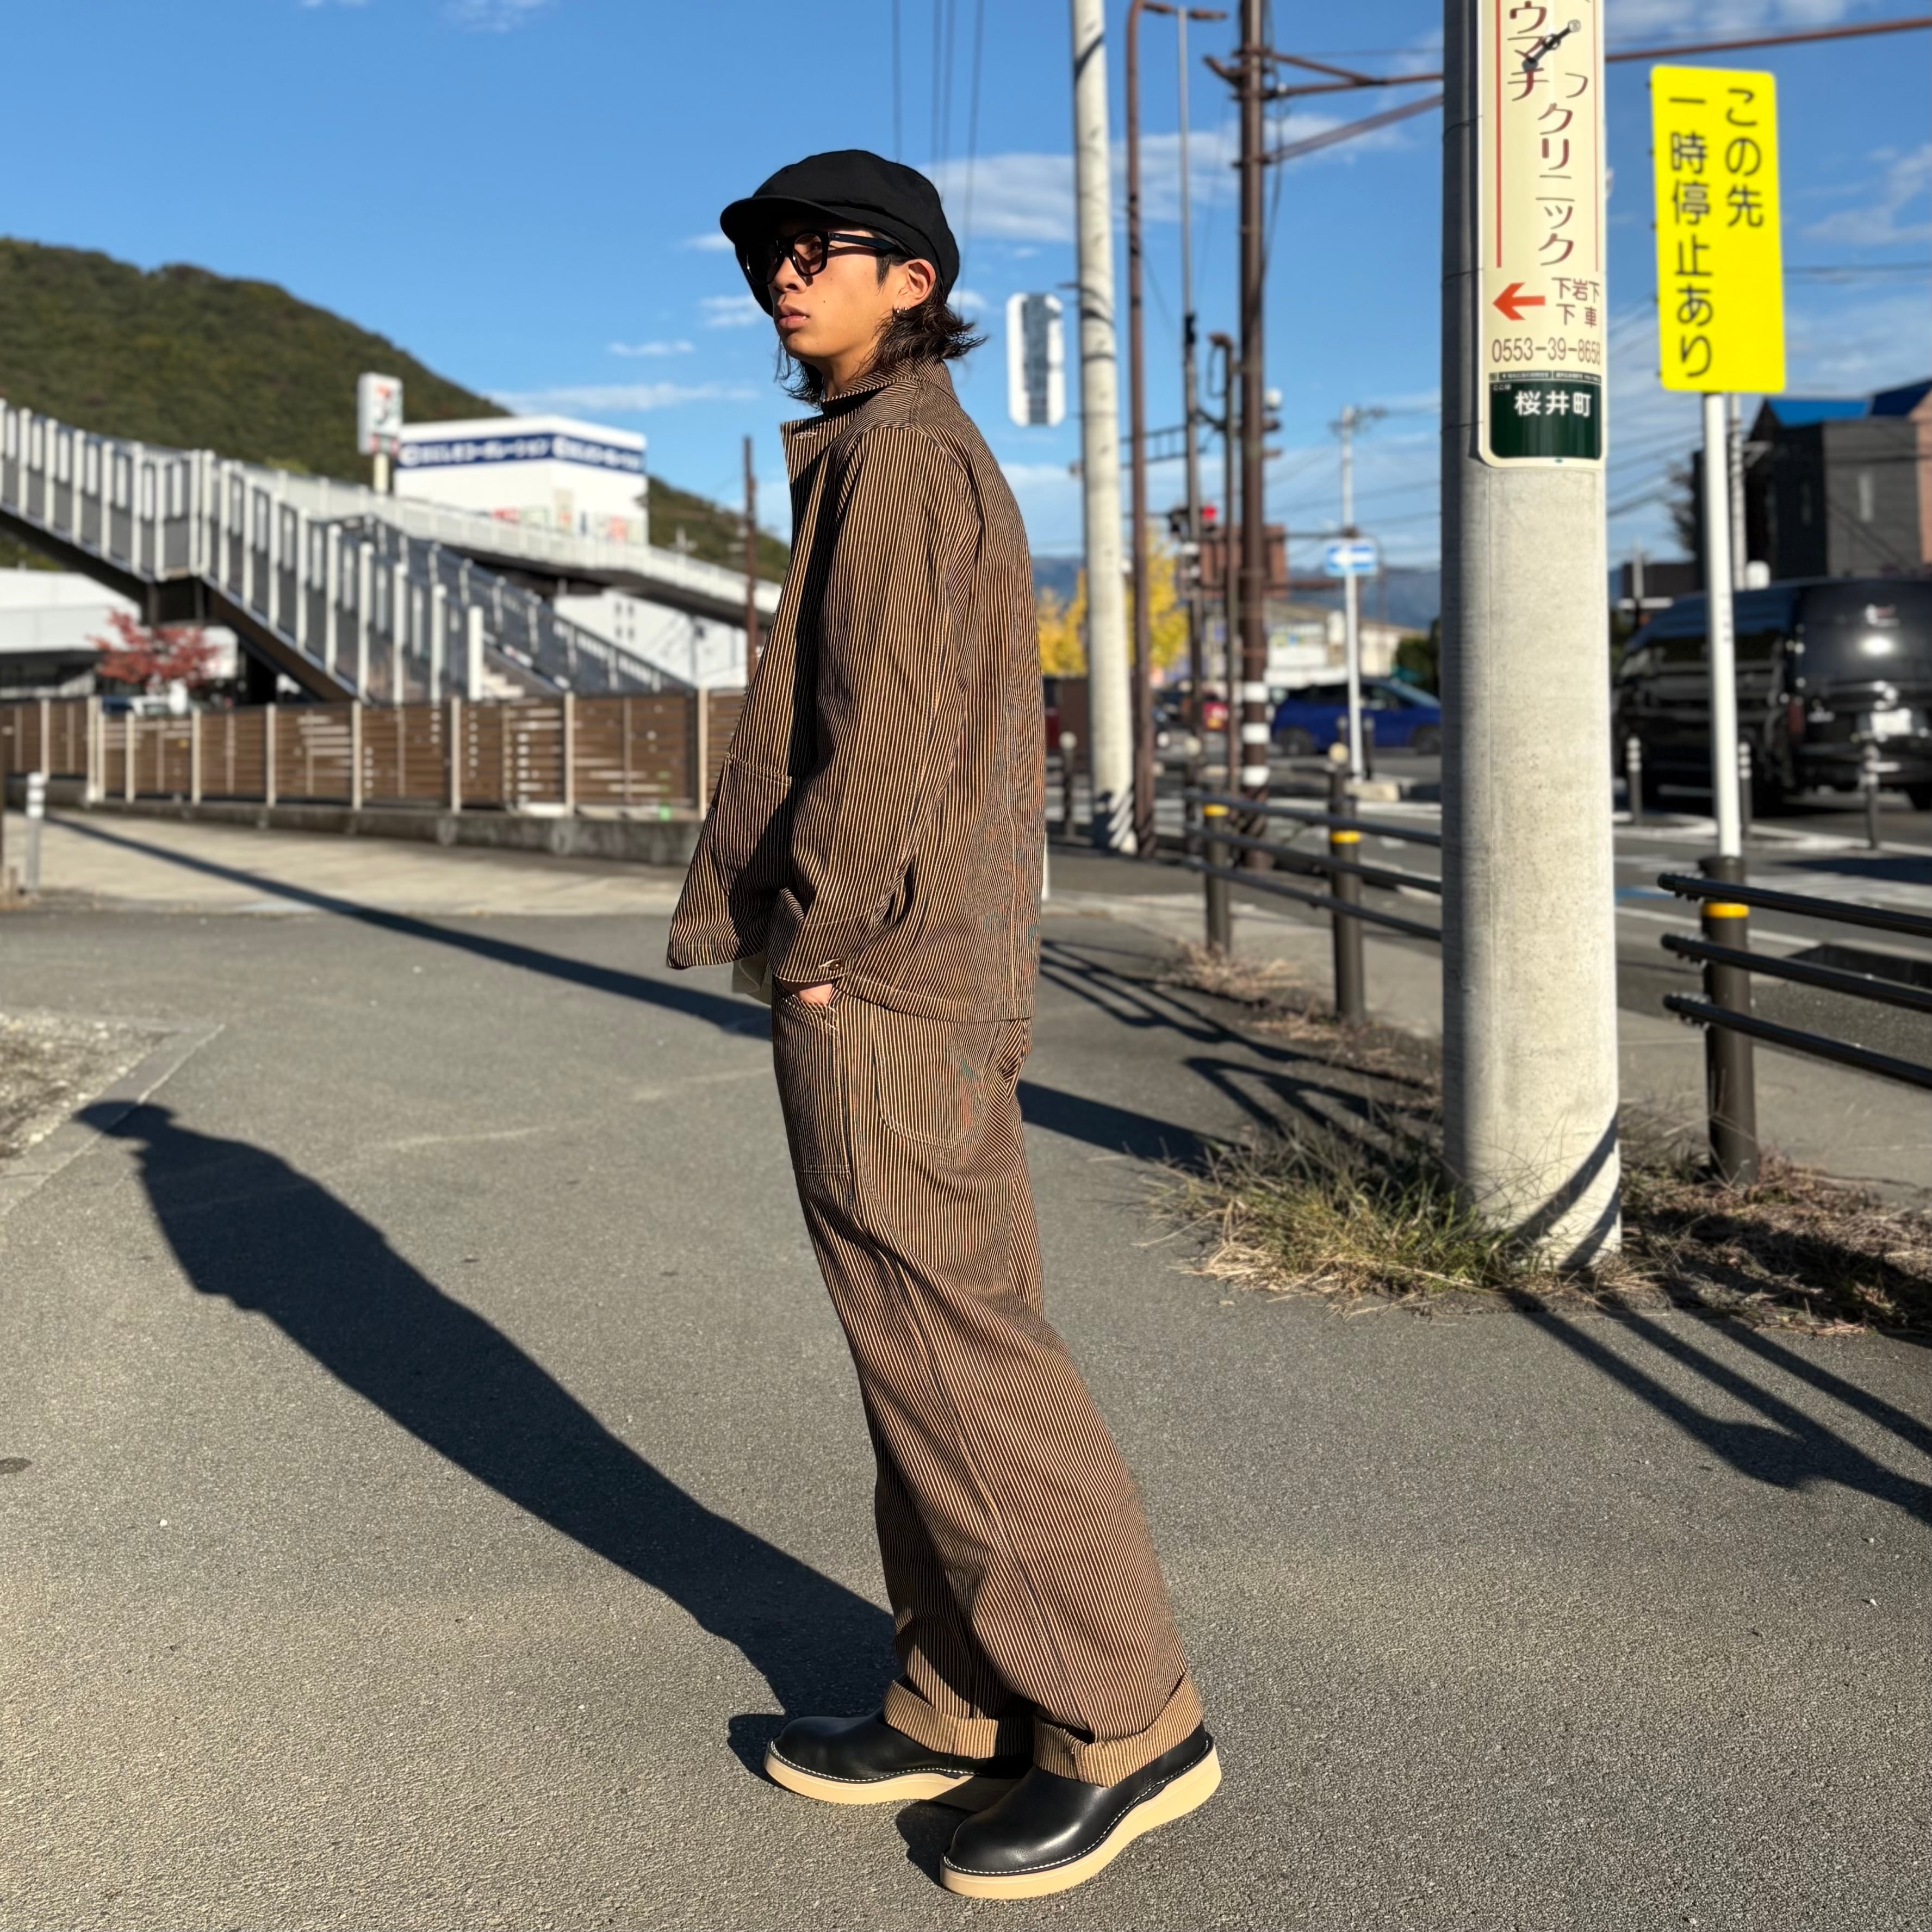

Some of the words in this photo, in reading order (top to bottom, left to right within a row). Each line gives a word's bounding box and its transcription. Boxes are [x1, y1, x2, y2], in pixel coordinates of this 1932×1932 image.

[1536, 102, 1575, 266] クリニック
[1725, 88, 1764, 228] この先
[1669, 97, 1713, 378] 一時停止あり
[1551, 277, 1600, 303] 下岩下
[1492, 337, 1601, 365] 0553-39-8658
[1515, 390, 1591, 417] 桜井町
